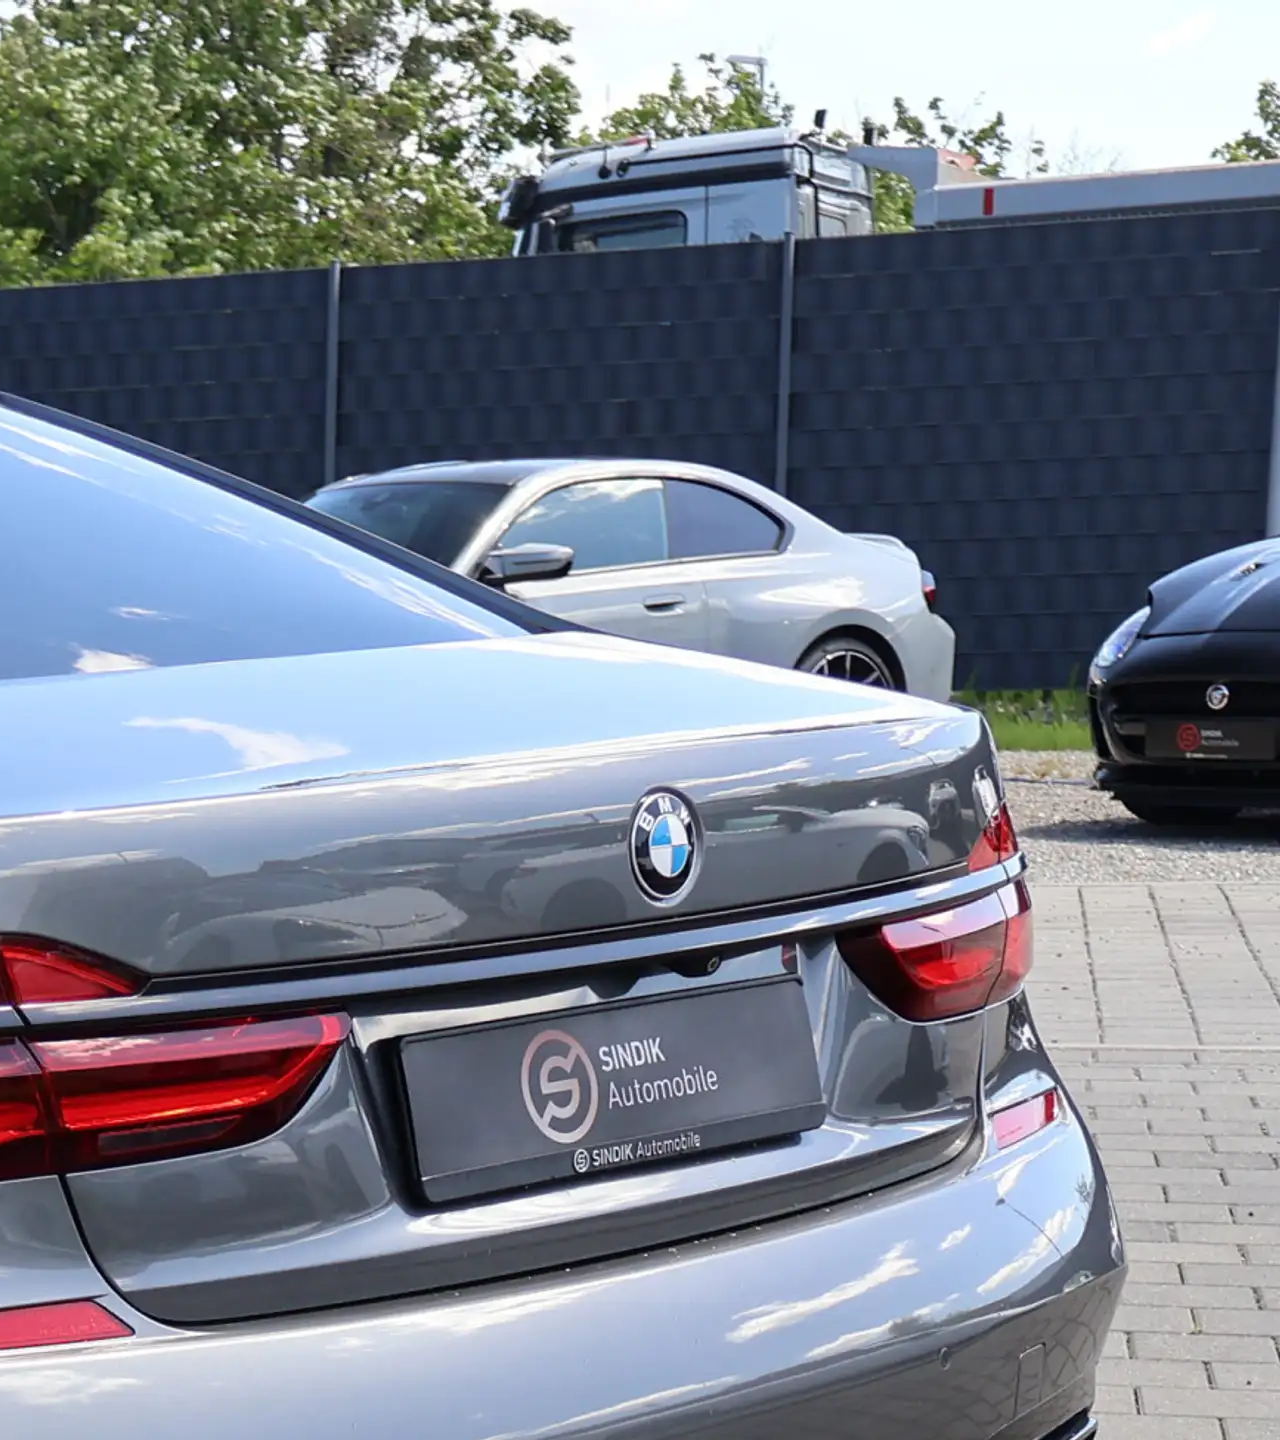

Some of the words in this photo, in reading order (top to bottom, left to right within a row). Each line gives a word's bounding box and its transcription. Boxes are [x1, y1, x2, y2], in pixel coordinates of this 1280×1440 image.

[639, 796, 691, 832] BMW
[599, 1037, 666, 1072] SINDIK
[608, 1065, 719, 1110] Automobile
[592, 1143, 634, 1166] SINDIK
[636, 1131, 700, 1159] Automobile
